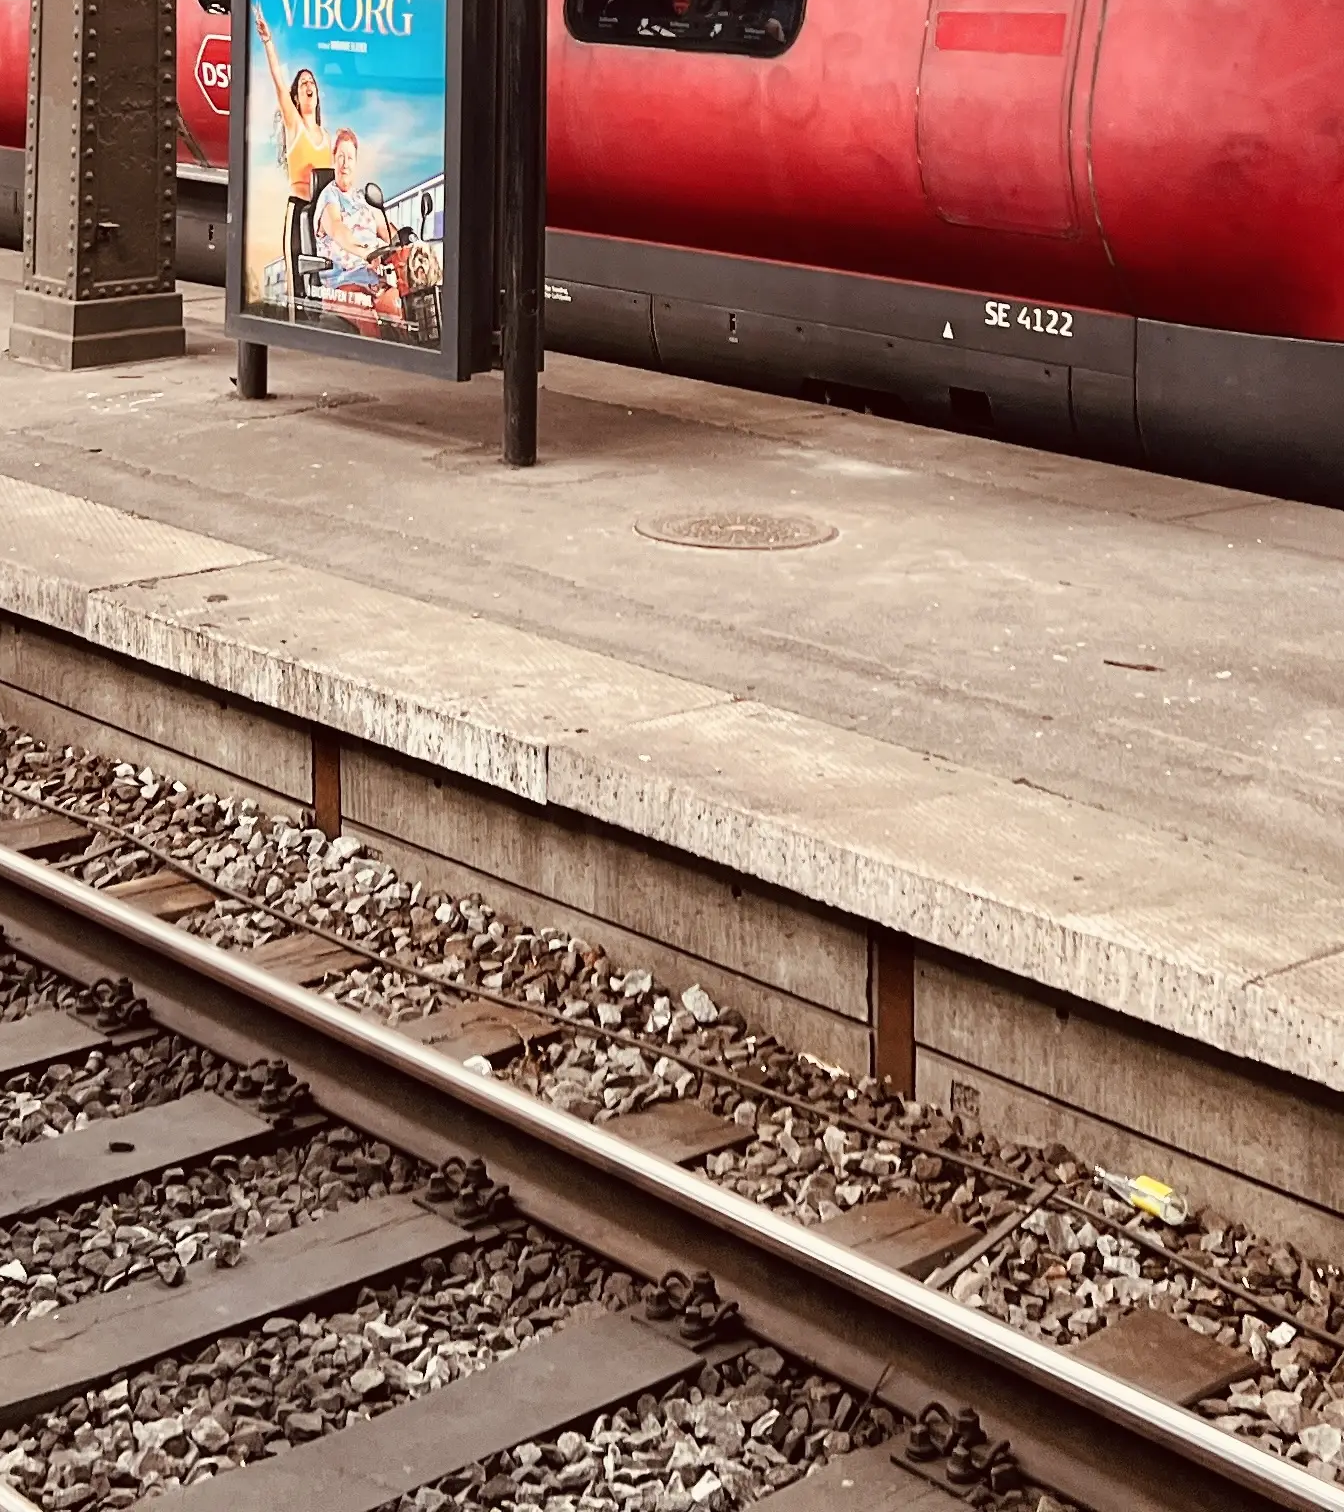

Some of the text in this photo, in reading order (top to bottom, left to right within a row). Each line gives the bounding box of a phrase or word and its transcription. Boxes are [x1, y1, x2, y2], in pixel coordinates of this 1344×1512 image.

[202, 62, 232, 88] DS
[984, 301, 1074, 338] SE 4122
